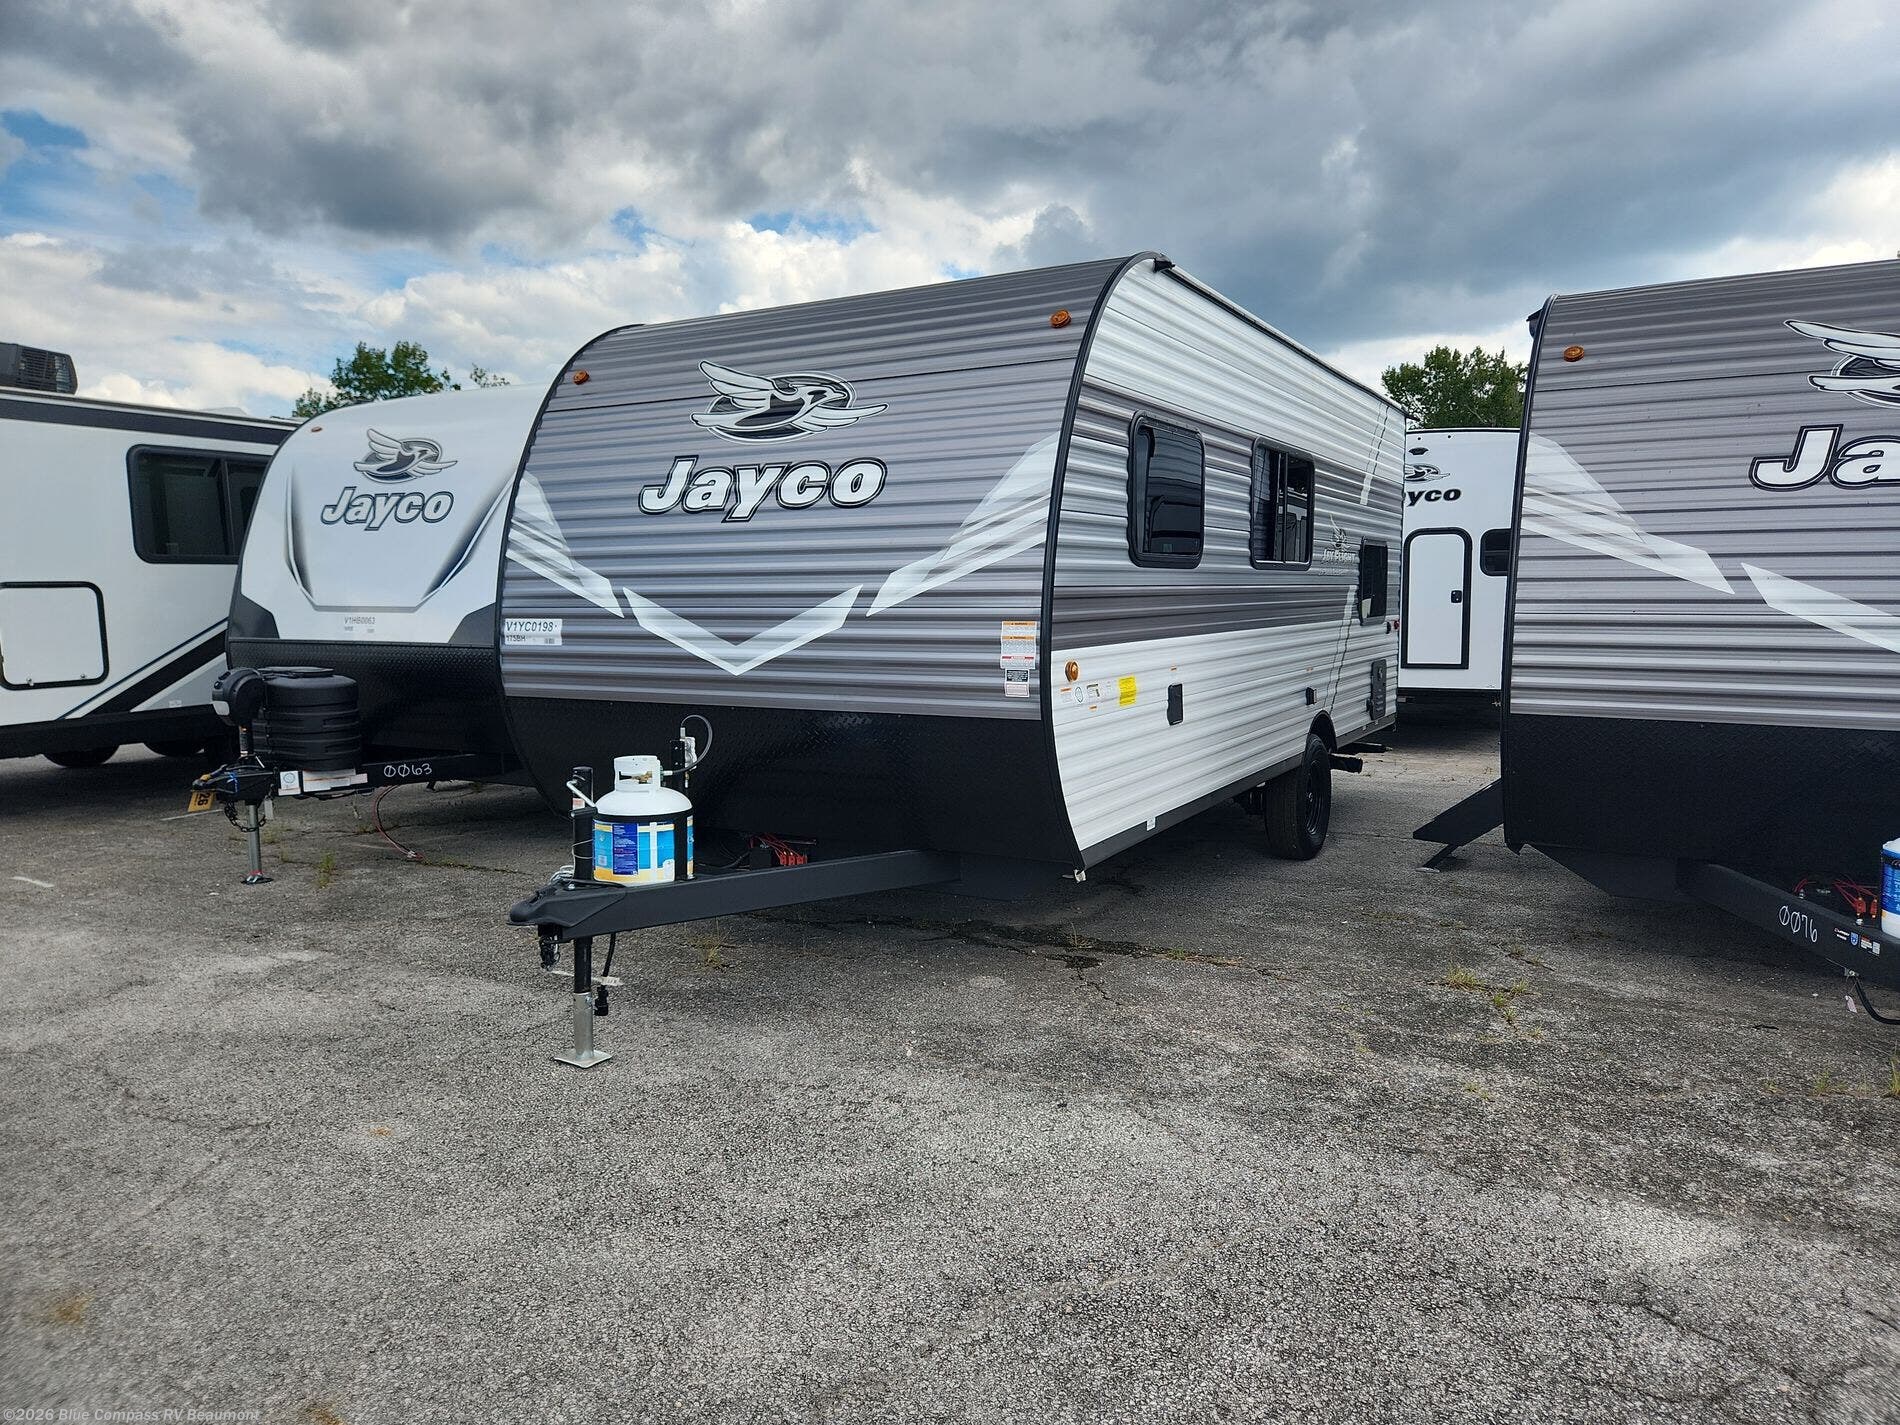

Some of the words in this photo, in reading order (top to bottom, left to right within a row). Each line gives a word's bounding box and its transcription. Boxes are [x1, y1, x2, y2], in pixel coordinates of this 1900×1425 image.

[1748, 423, 1900, 492] Ja
[320, 485, 454, 531] Jayco
[638, 454, 888, 524] Jayco
[1406, 488, 1462, 507] yco
[505, 621, 554, 632] V1YC0198
[383, 762, 433, 778] 0063
[1779, 905, 1818, 943] 0076
